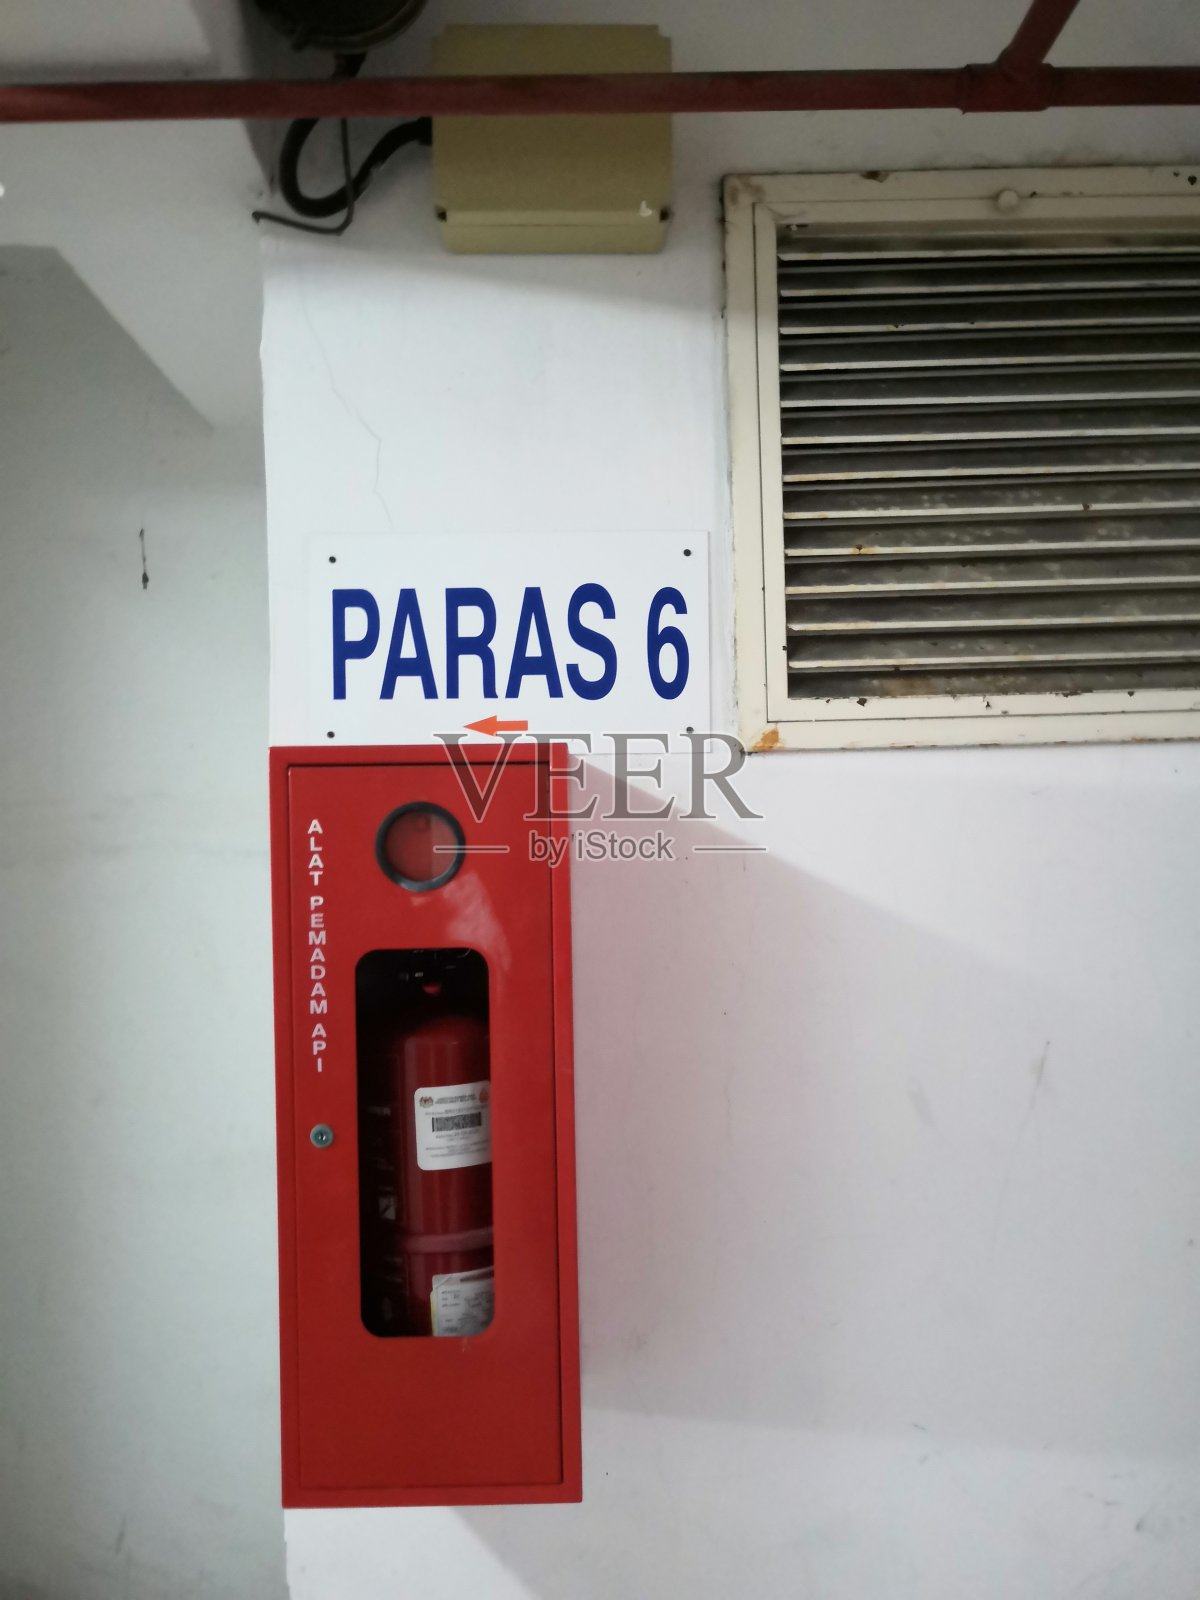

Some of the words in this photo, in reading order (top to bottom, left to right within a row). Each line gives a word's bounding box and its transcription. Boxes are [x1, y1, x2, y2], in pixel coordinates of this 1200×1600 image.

[331, 583, 617, 700] PARAS
[647, 587, 690, 700] 6
[307, 819, 324, 886] ALAT
[308, 895, 328, 1014] PEMADAM
[311, 1022, 327, 1073] API
